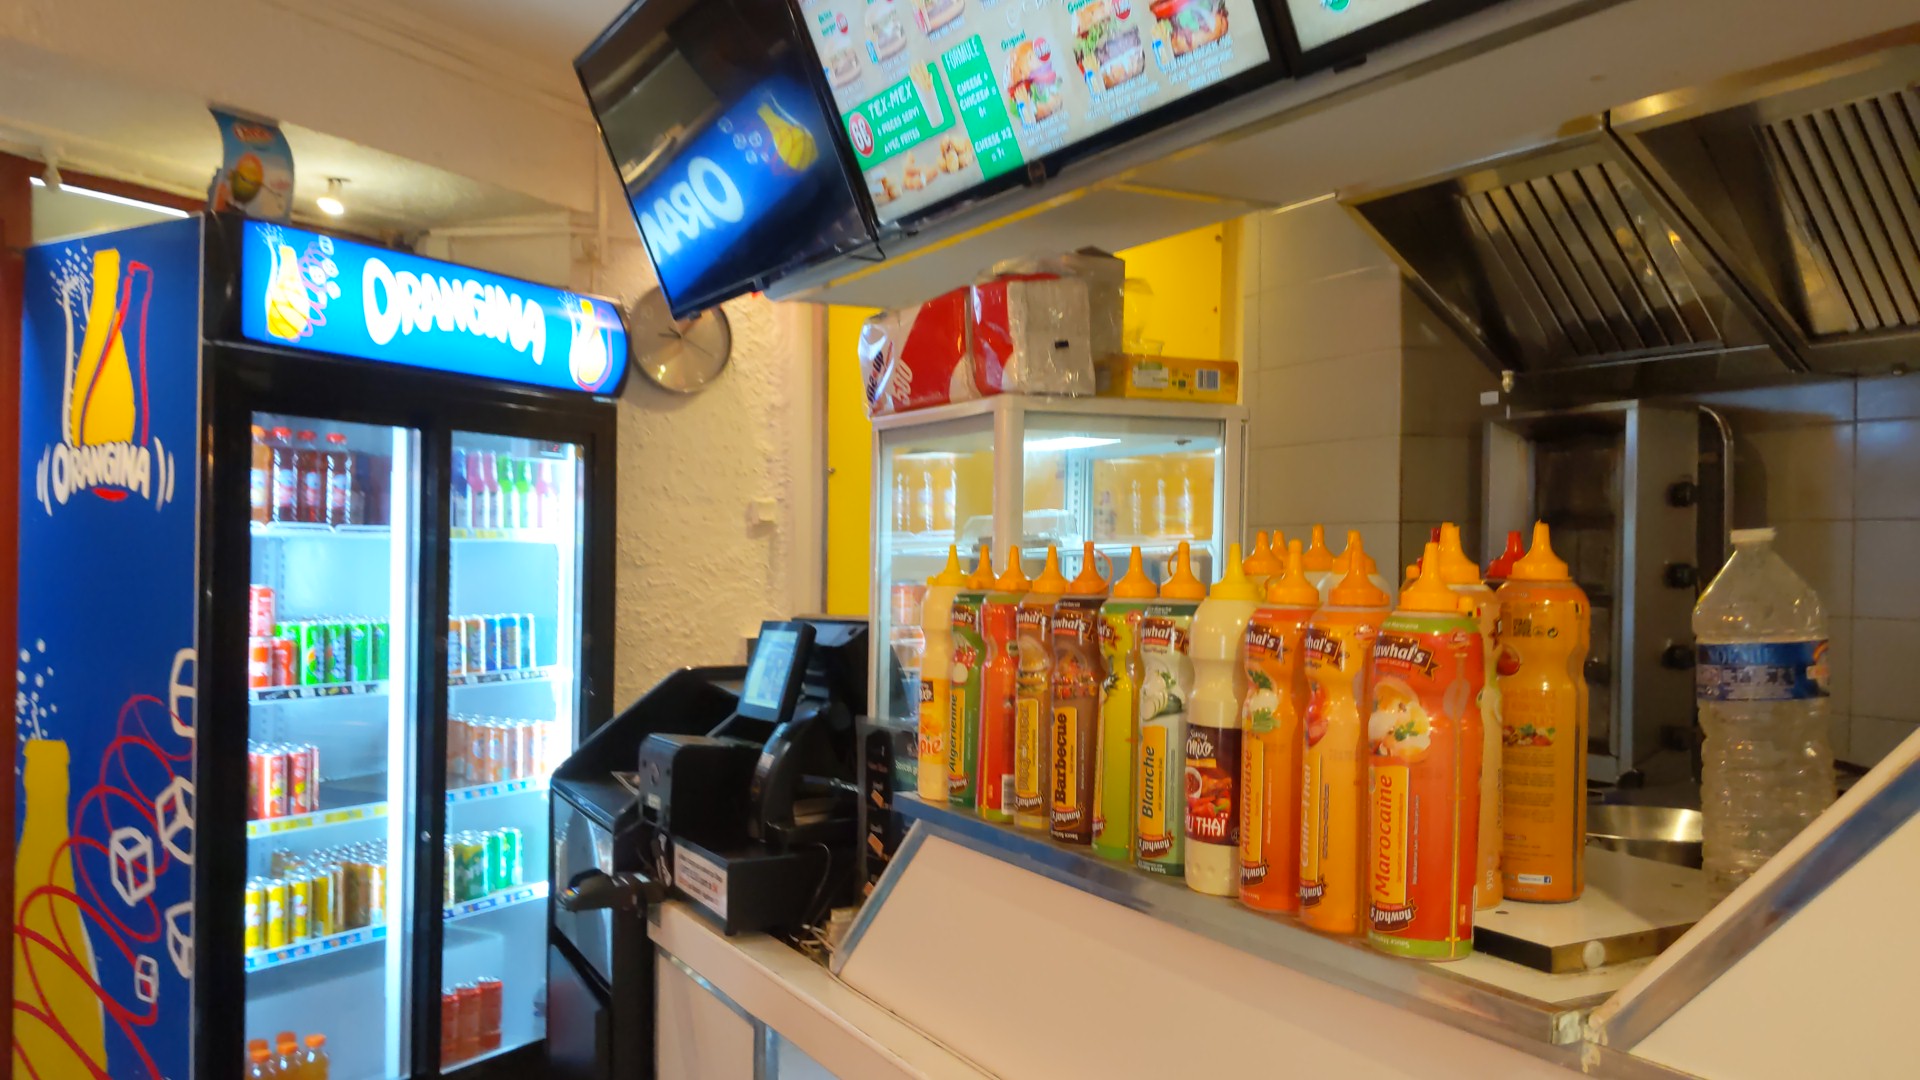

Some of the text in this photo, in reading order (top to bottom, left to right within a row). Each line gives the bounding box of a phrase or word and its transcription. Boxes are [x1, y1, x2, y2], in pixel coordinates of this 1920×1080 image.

[944, 35, 981, 71] FORMULE
[1000, 28, 1027, 52] Original
[867, 80, 913, 120] TEX-MEX
[362, 258, 546, 364] ORANGINA
[52, 441, 151, 505] ORANGINA
[1374, 642, 1426, 664] awhal's
[1054, 713, 1068, 805] Barbecue
[1143, 746, 1155, 819] Blanche
[1375, 774, 1393, 897] Marocaine
[1370, 907, 1412, 925] nawhal's
